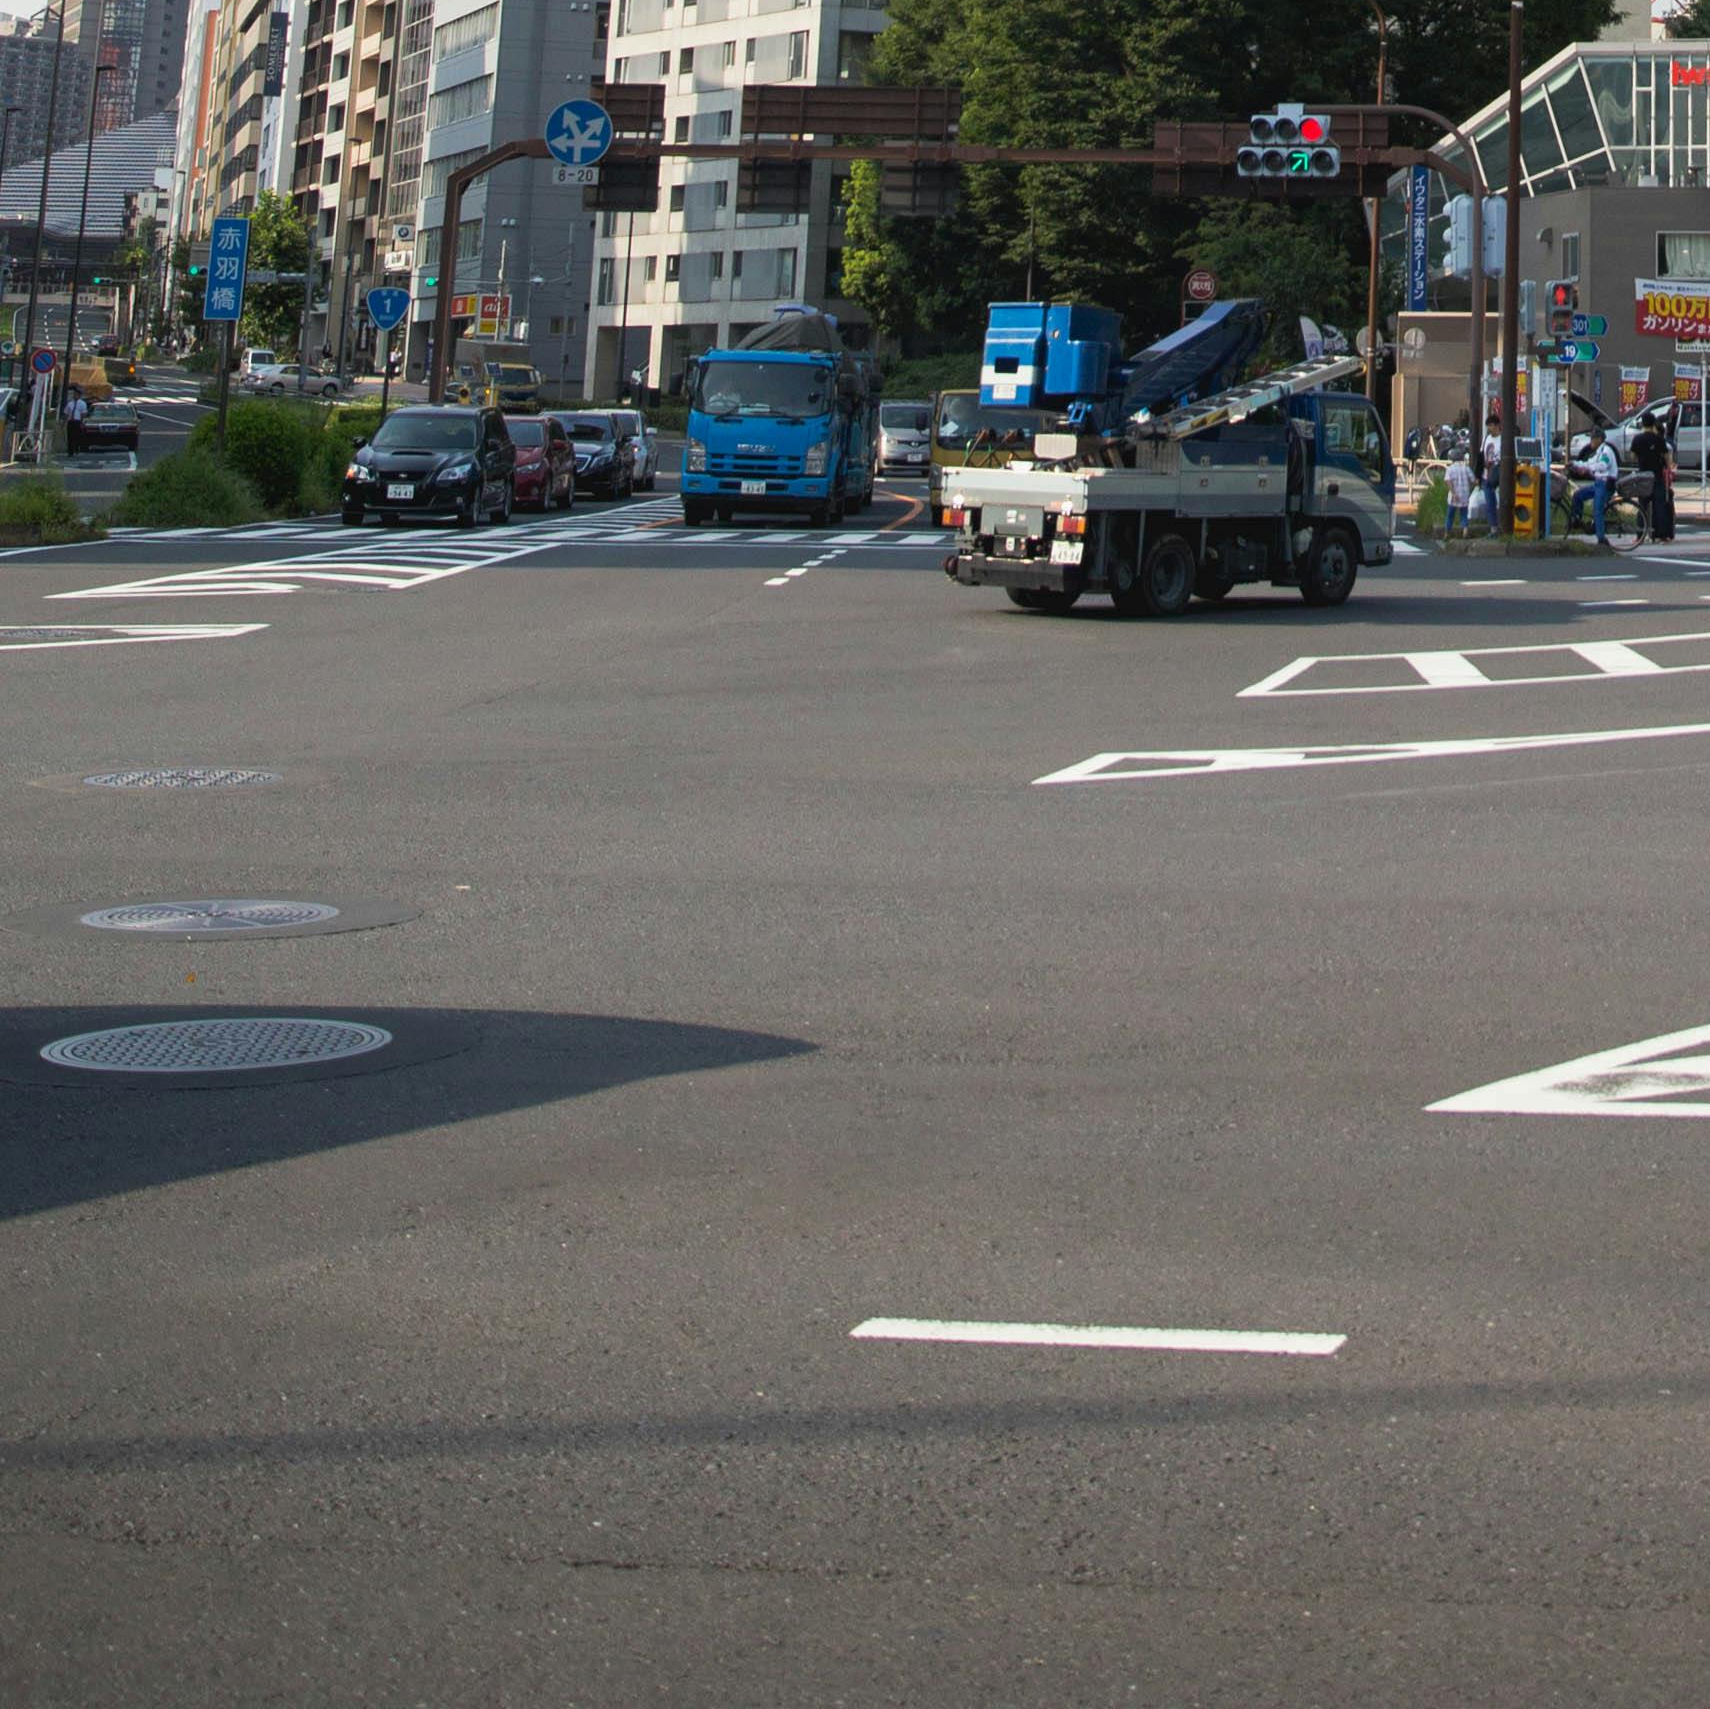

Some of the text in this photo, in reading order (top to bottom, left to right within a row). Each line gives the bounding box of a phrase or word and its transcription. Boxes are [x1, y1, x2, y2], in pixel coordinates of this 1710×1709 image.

[558, 169, 594, 182] 8-20
[211, 227, 243, 311] 赤羽橋
[1572, 319, 1588, 330] 301
